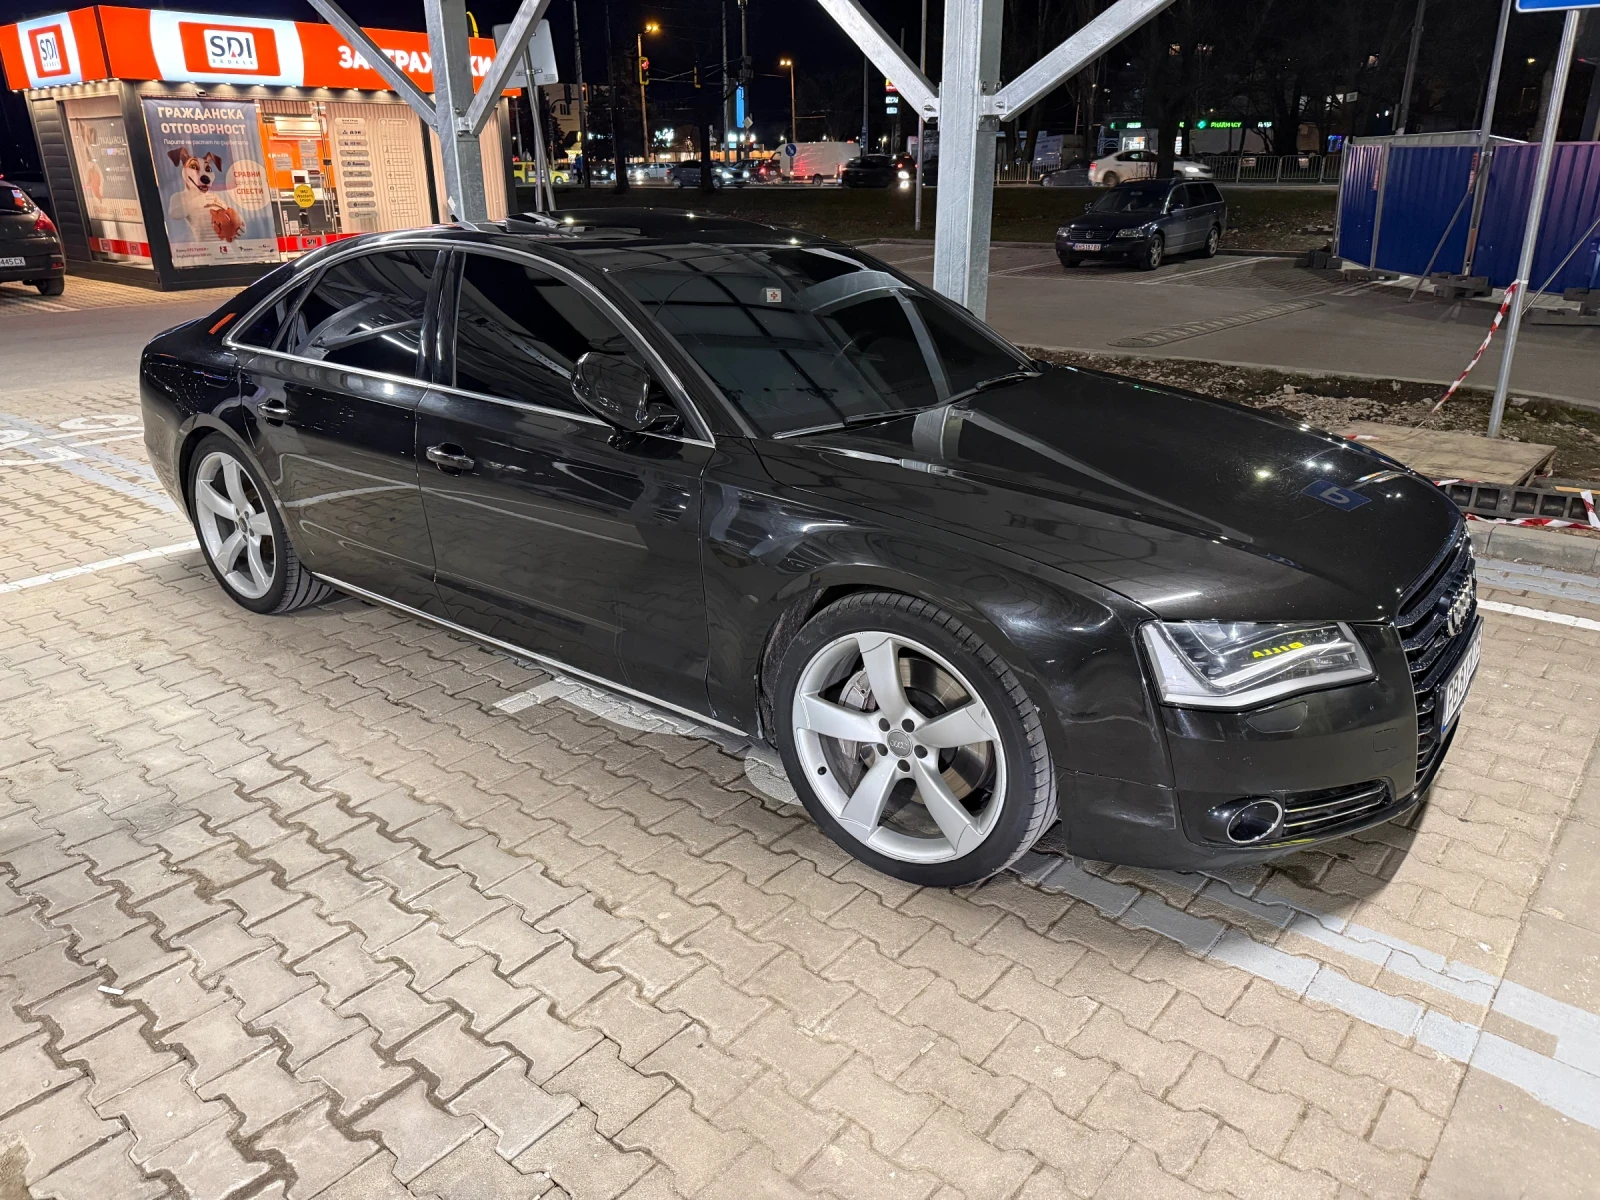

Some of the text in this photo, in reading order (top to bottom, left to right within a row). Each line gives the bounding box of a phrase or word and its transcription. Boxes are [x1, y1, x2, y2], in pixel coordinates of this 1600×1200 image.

[39, 37, 58, 61] SDI
[208, 35, 253, 58] SDI
[157, 106, 245, 121] ГРАЖДАНСКА
[160, 122, 246, 135] ОТГОВОРНОСТ
